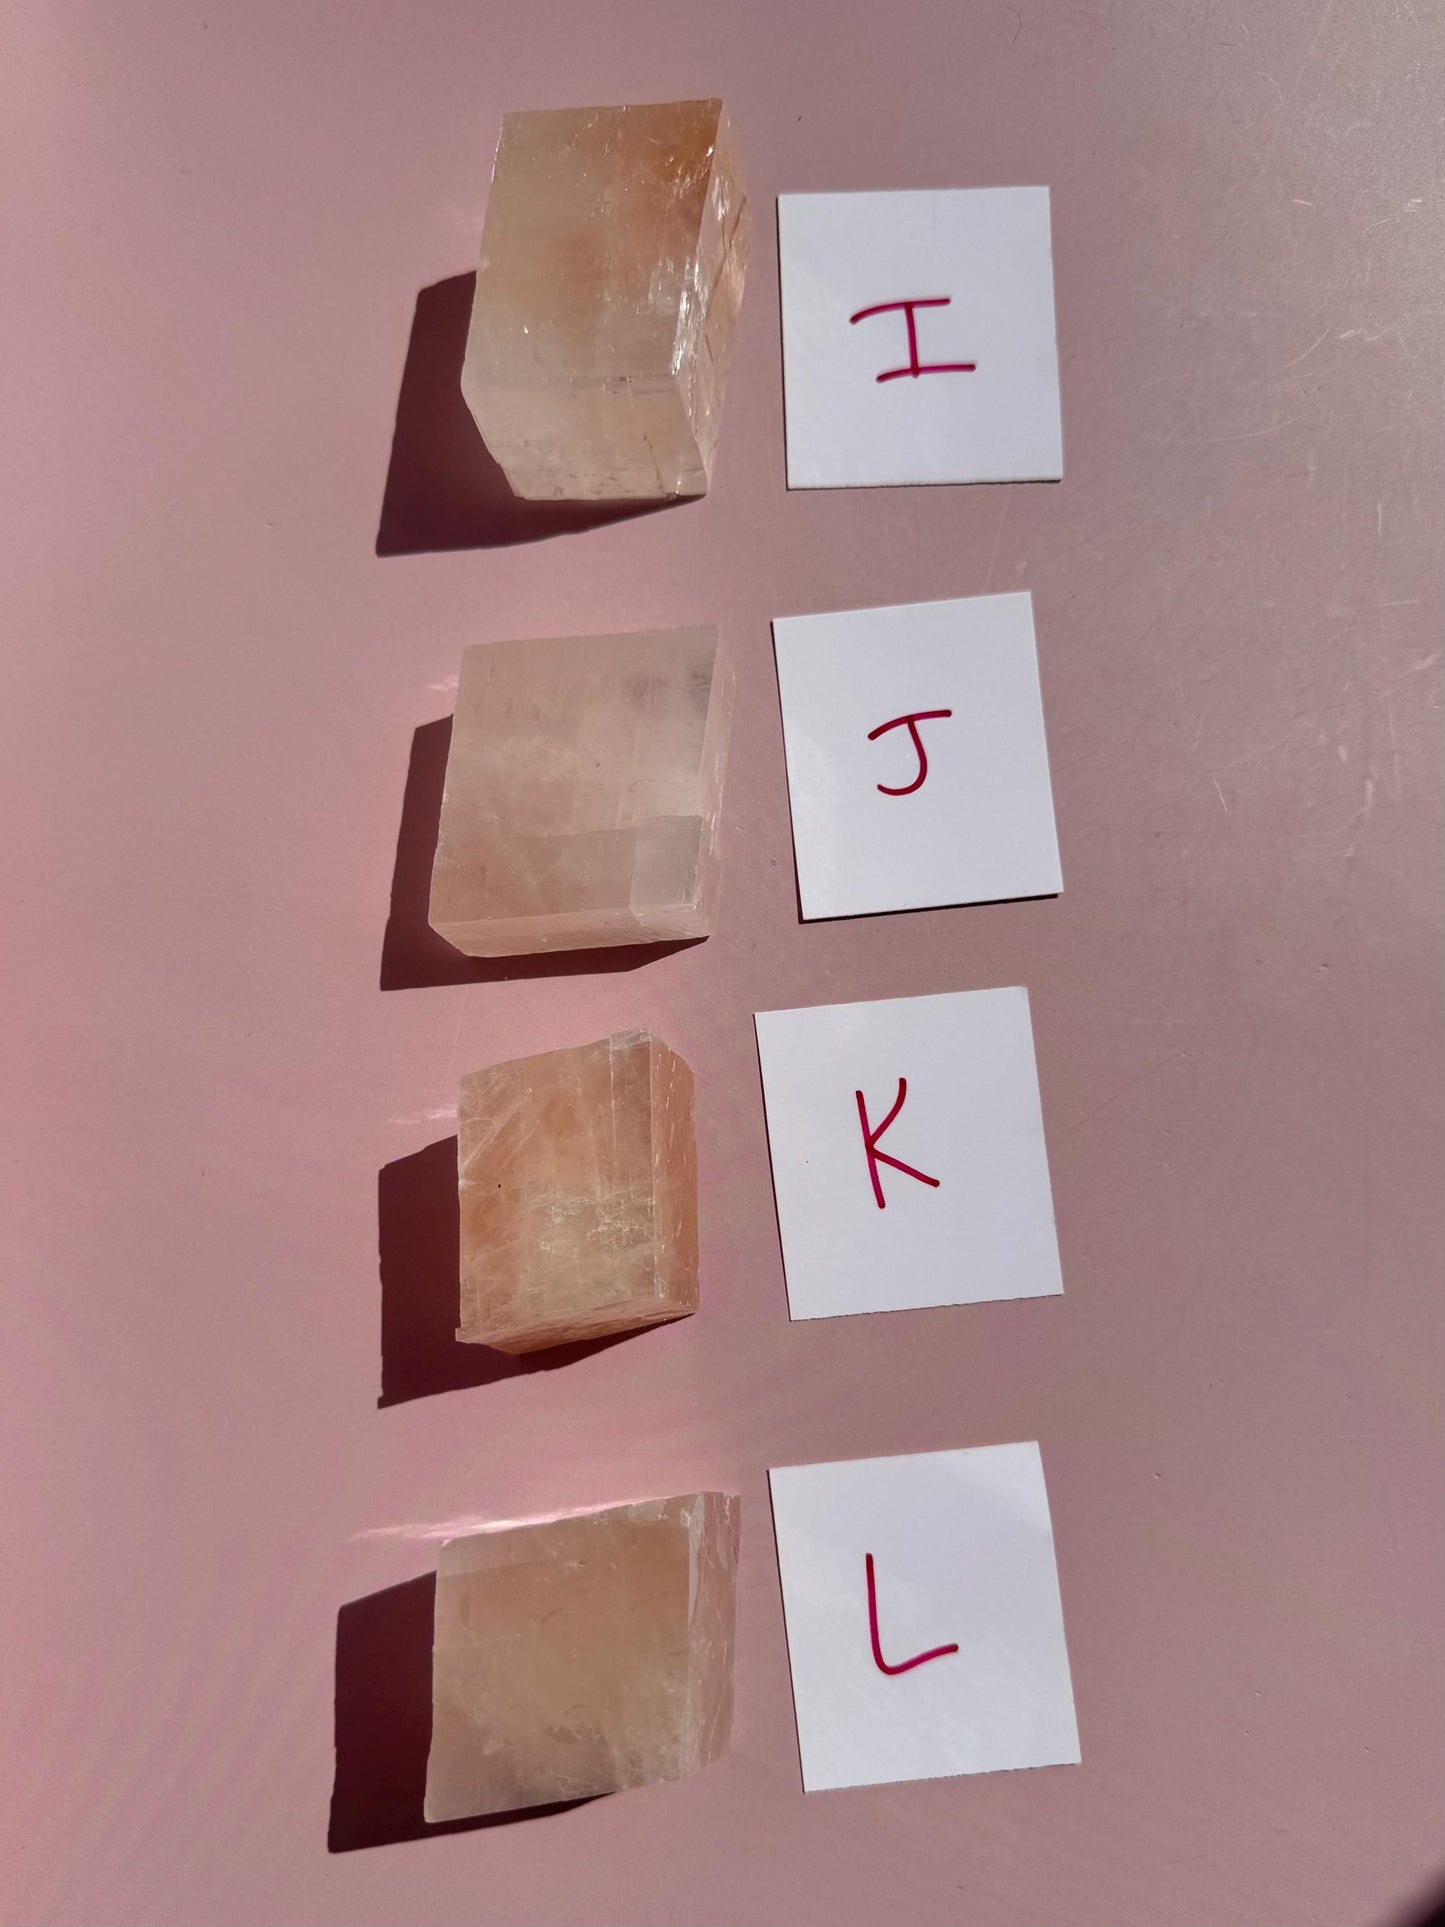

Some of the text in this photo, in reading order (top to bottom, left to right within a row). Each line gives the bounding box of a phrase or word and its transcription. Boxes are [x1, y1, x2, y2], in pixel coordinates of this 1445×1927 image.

[850, 295, 976, 383] I
[867, 708, 952, 797] J
[855, 1077, 940, 1210] K
[866, 1552, 959, 1675] L
